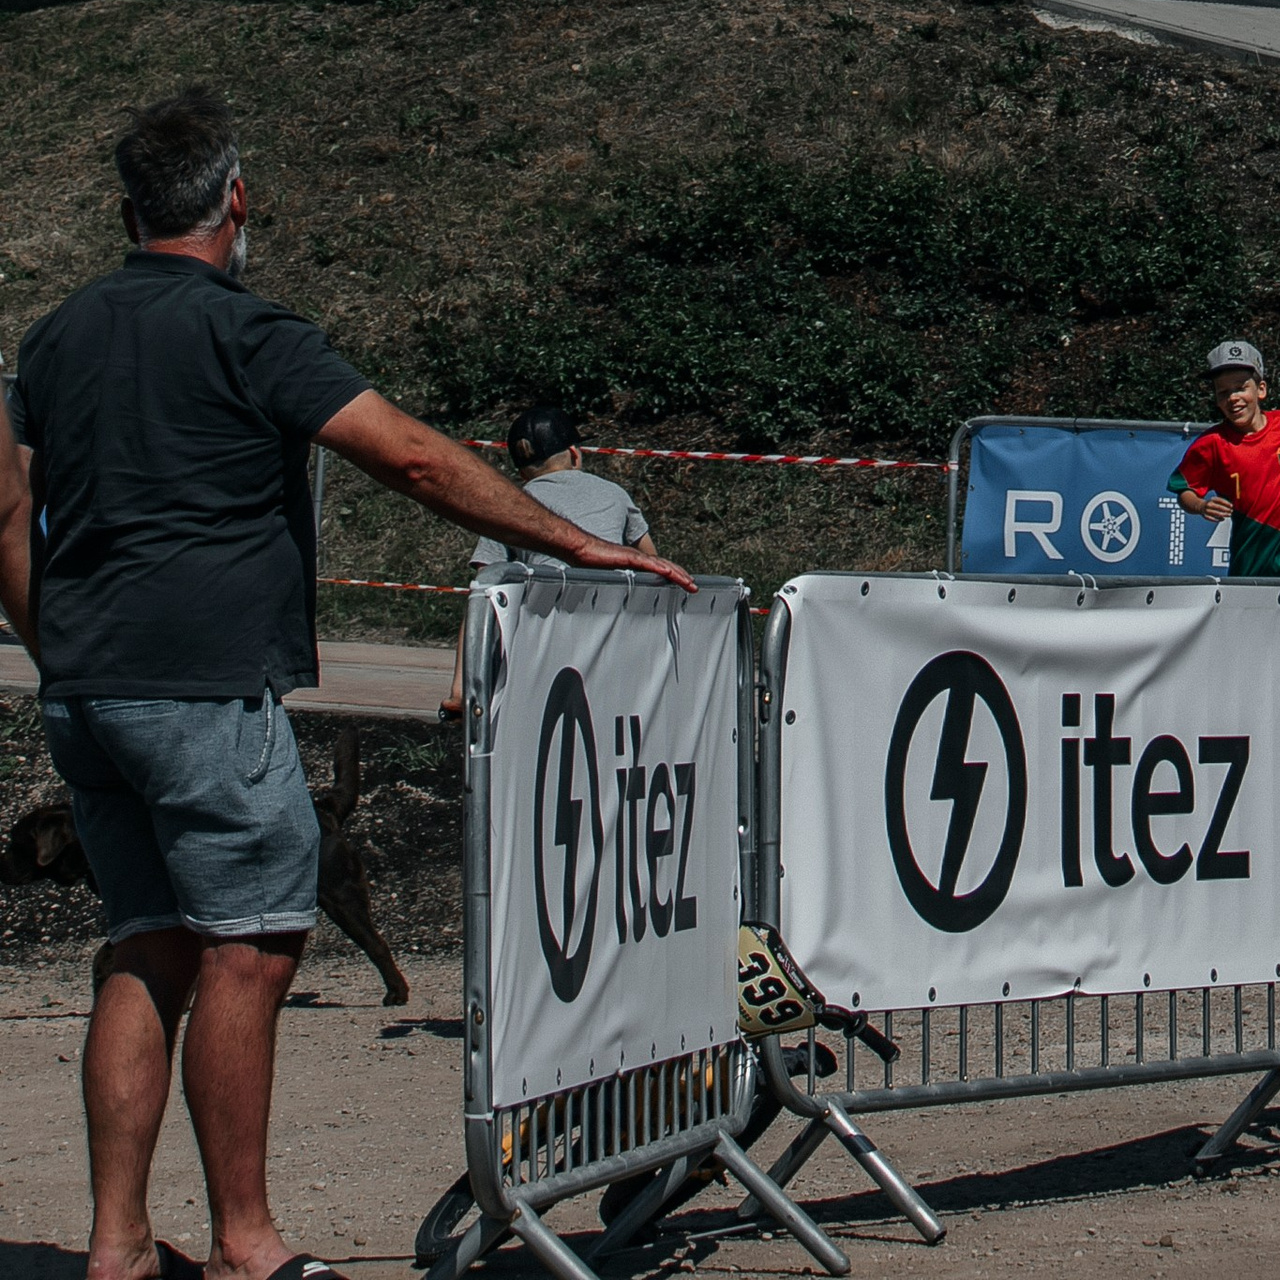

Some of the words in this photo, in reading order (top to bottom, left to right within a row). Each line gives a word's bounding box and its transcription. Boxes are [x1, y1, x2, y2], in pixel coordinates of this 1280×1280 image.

[614, 714, 698, 945] itez
[1060, 692, 1252, 888] itez
[738, 952, 804, 1026] 399
